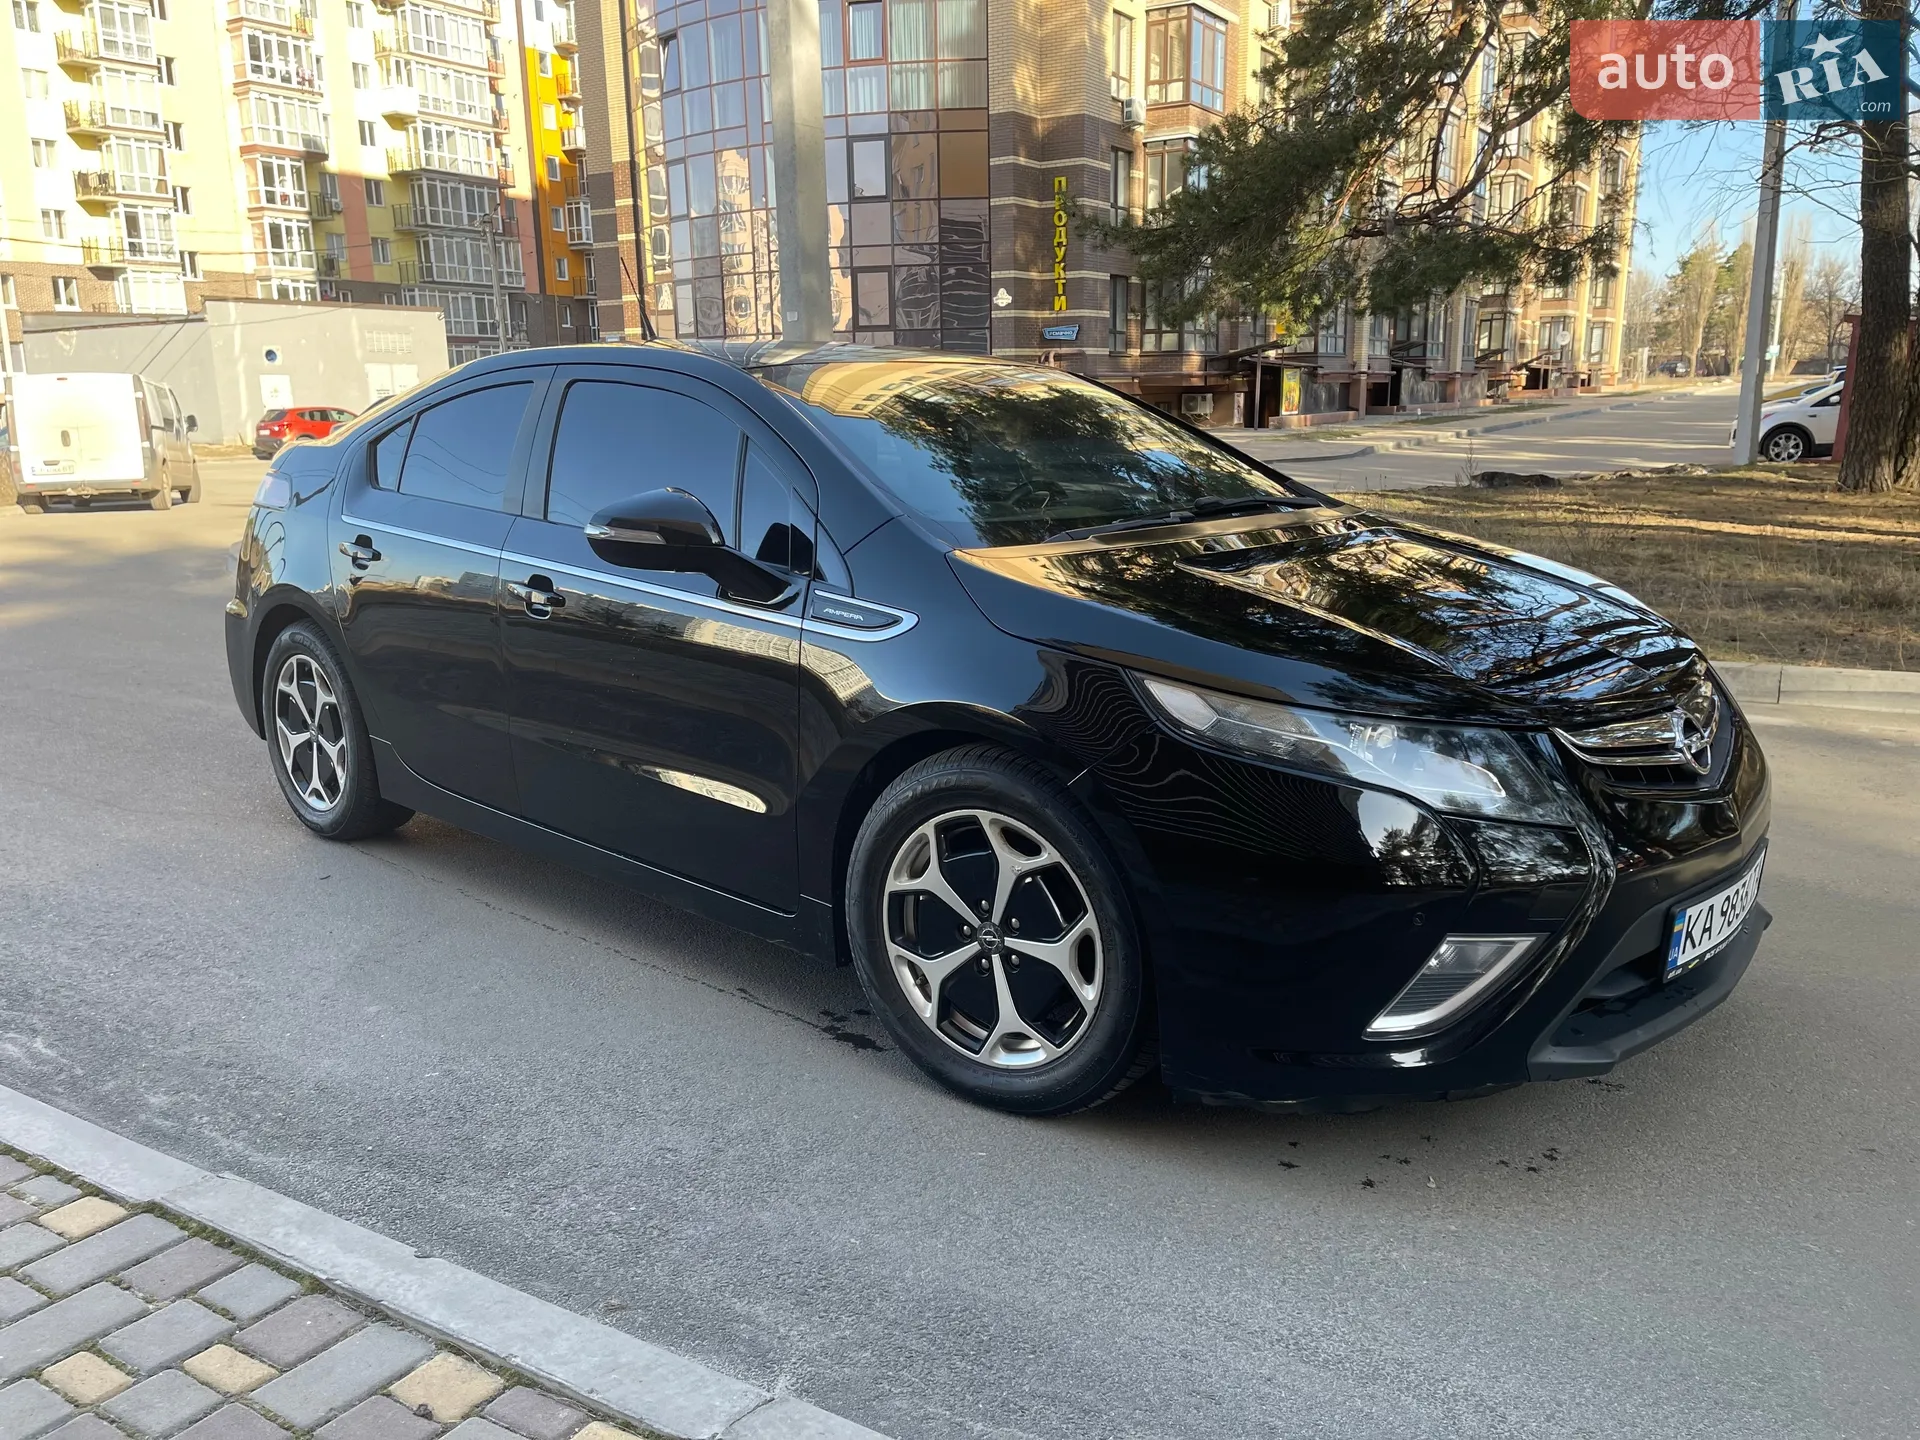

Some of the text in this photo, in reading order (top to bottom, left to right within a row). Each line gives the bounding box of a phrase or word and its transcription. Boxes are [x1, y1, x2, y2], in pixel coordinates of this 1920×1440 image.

[1053, 176, 1068, 311] ПРОДУКТИ
[823, 608, 864, 621] AMPERA
[1682, 903, 1715, 955] KA
[1668, 946, 1679, 962] UA
